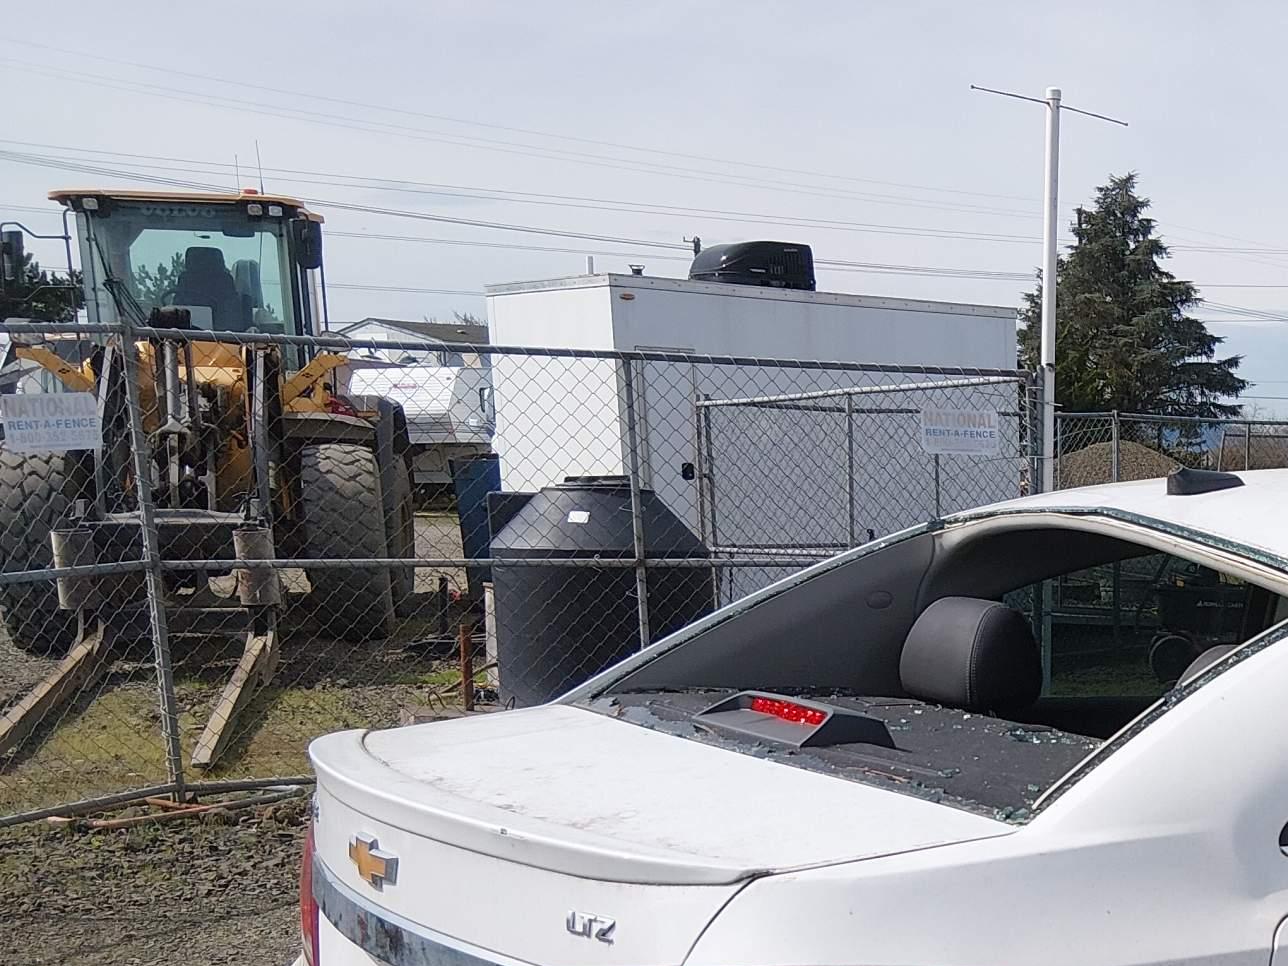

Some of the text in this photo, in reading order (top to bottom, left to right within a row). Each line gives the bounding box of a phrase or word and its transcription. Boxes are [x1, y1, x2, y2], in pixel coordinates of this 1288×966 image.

[3, 397, 97, 418] NATIONAL
[8, 417, 97, 431] RENT-A-FENCE
[923, 410, 996, 429] NATIONAL
[925, 428, 996, 439] RENT-A-FENCE
[566, 910, 616, 945] LTZ
